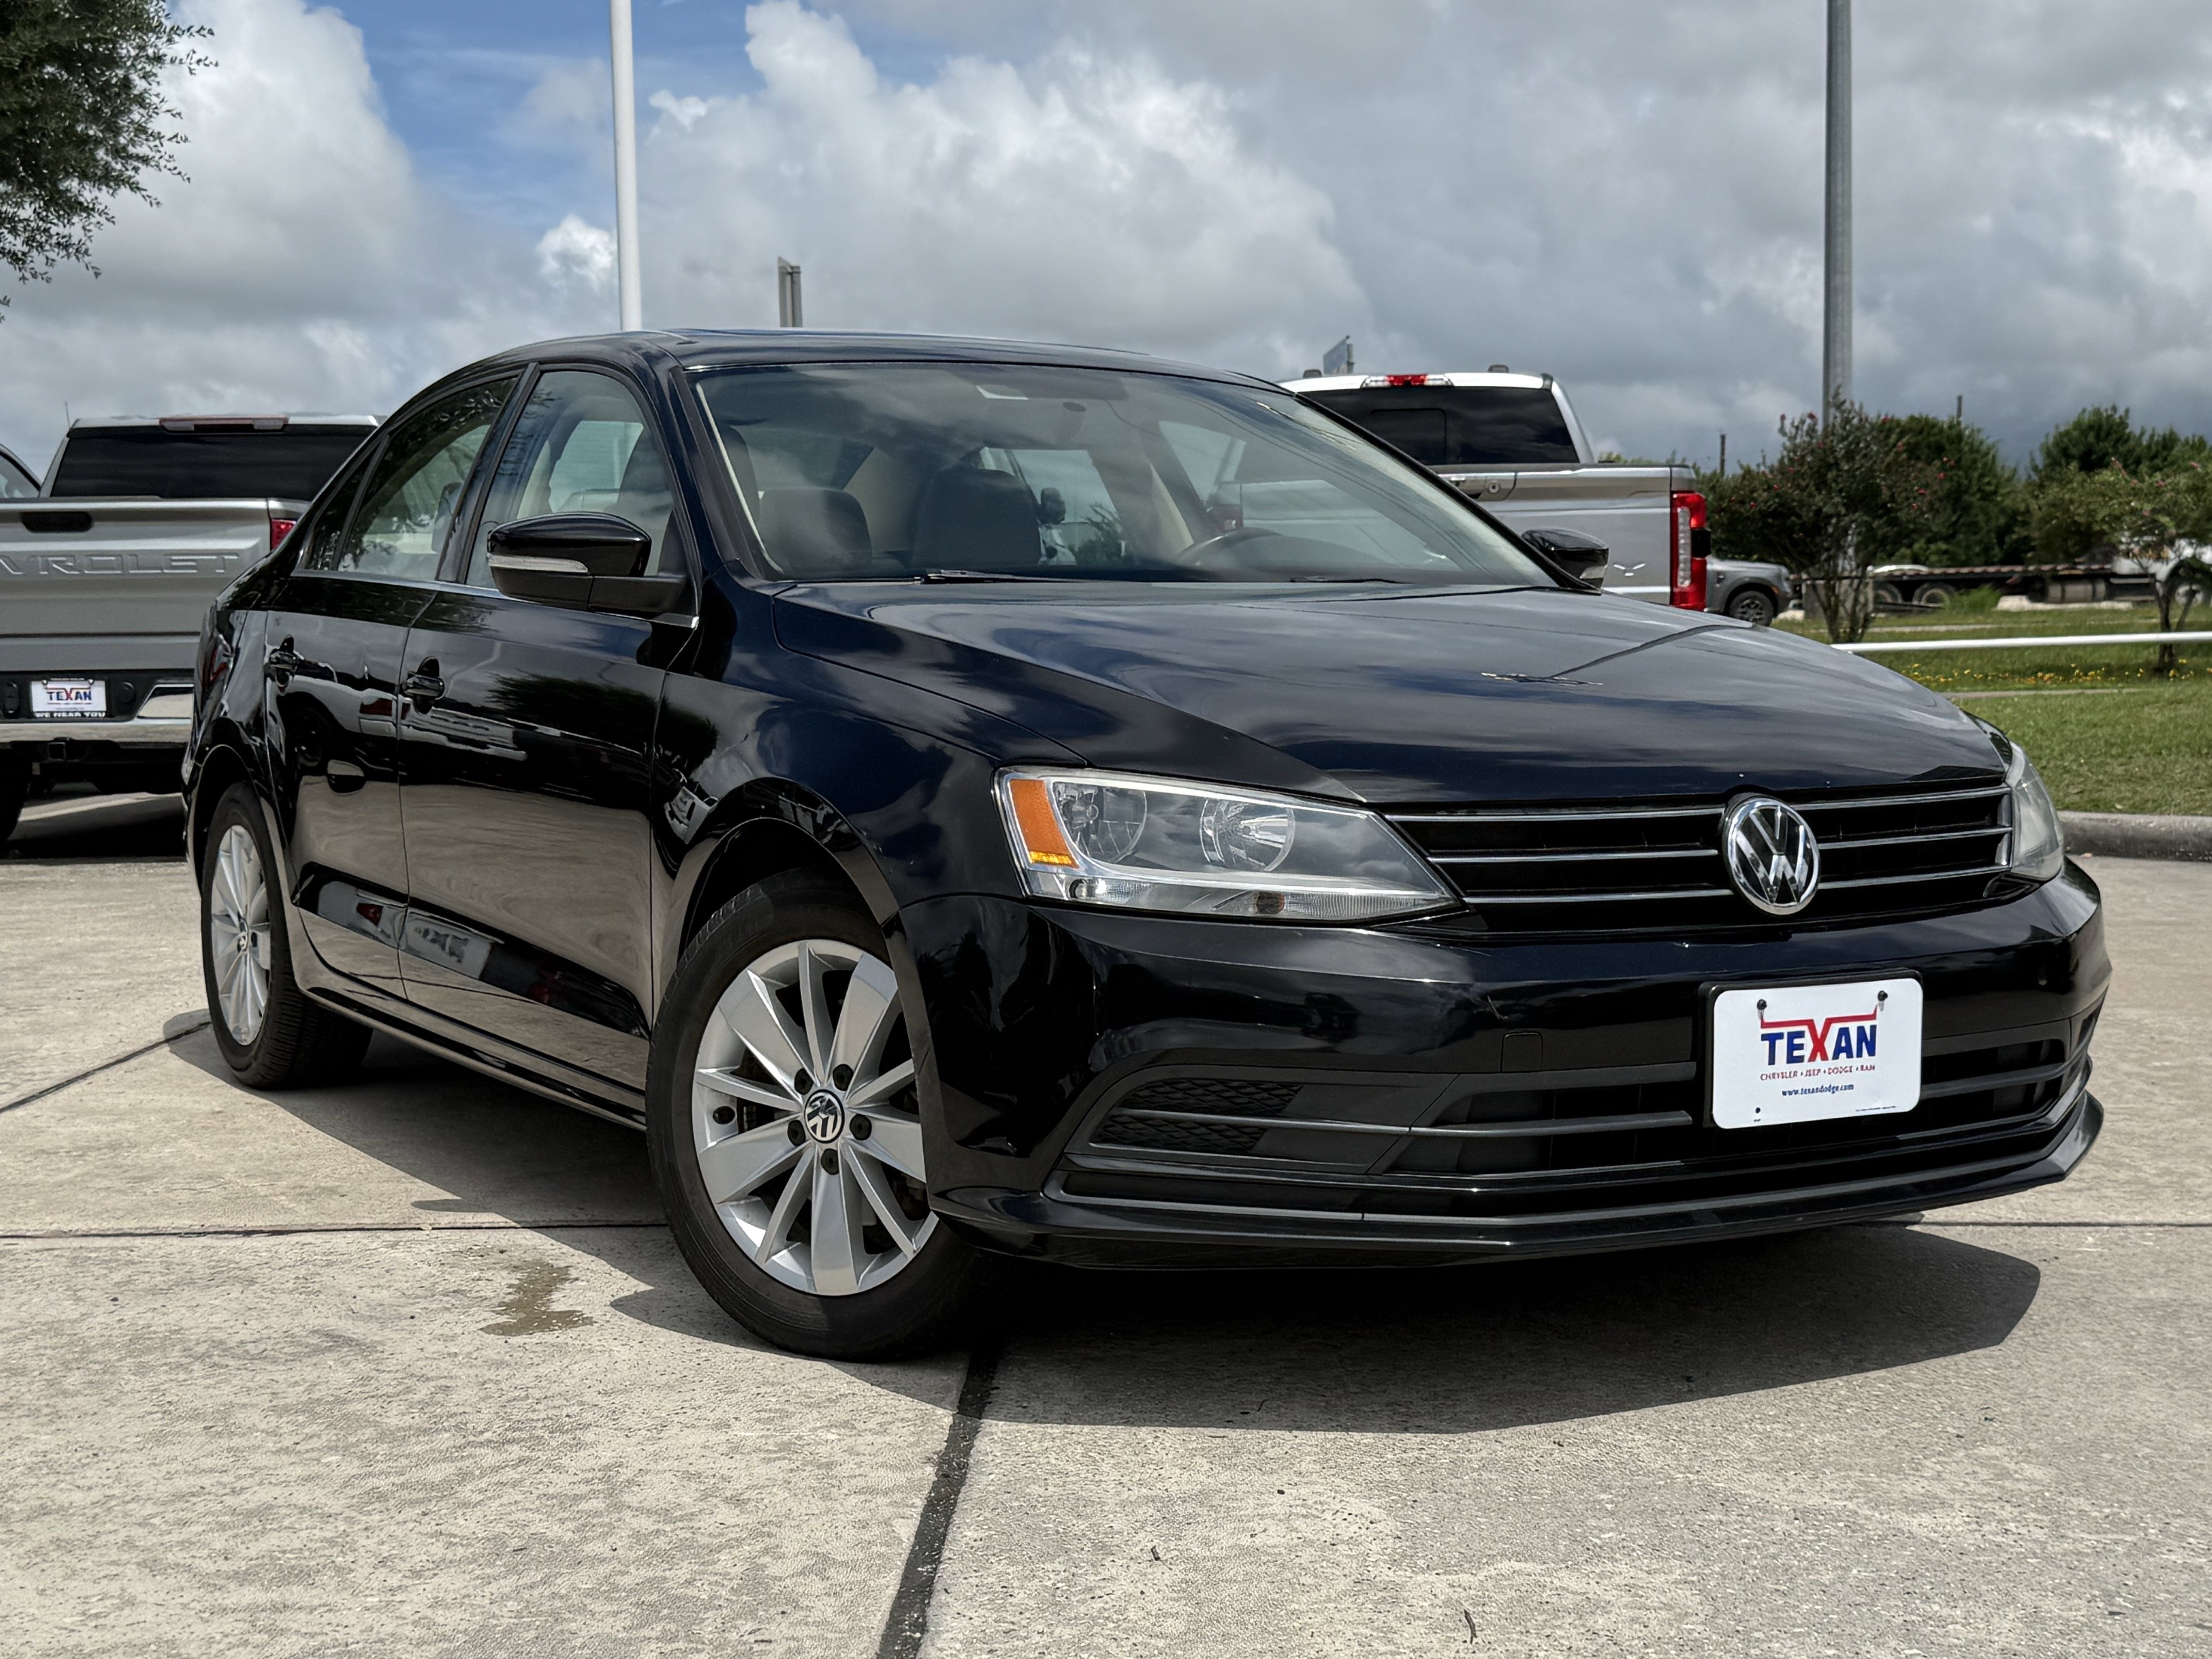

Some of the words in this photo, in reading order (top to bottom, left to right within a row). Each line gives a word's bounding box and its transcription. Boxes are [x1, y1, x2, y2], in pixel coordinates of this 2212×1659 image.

[46, 689, 92, 701] TEXAN
[1760, 1018, 1877, 1066] TEXAN
[1760, 1070, 1798, 1081] CHRYSLER
[1804, 1068, 1821, 1077] JEEP
[1828, 1066, 1853, 1075] DODGE
[1782, 1084, 1854, 1096] www.texandodge.com
